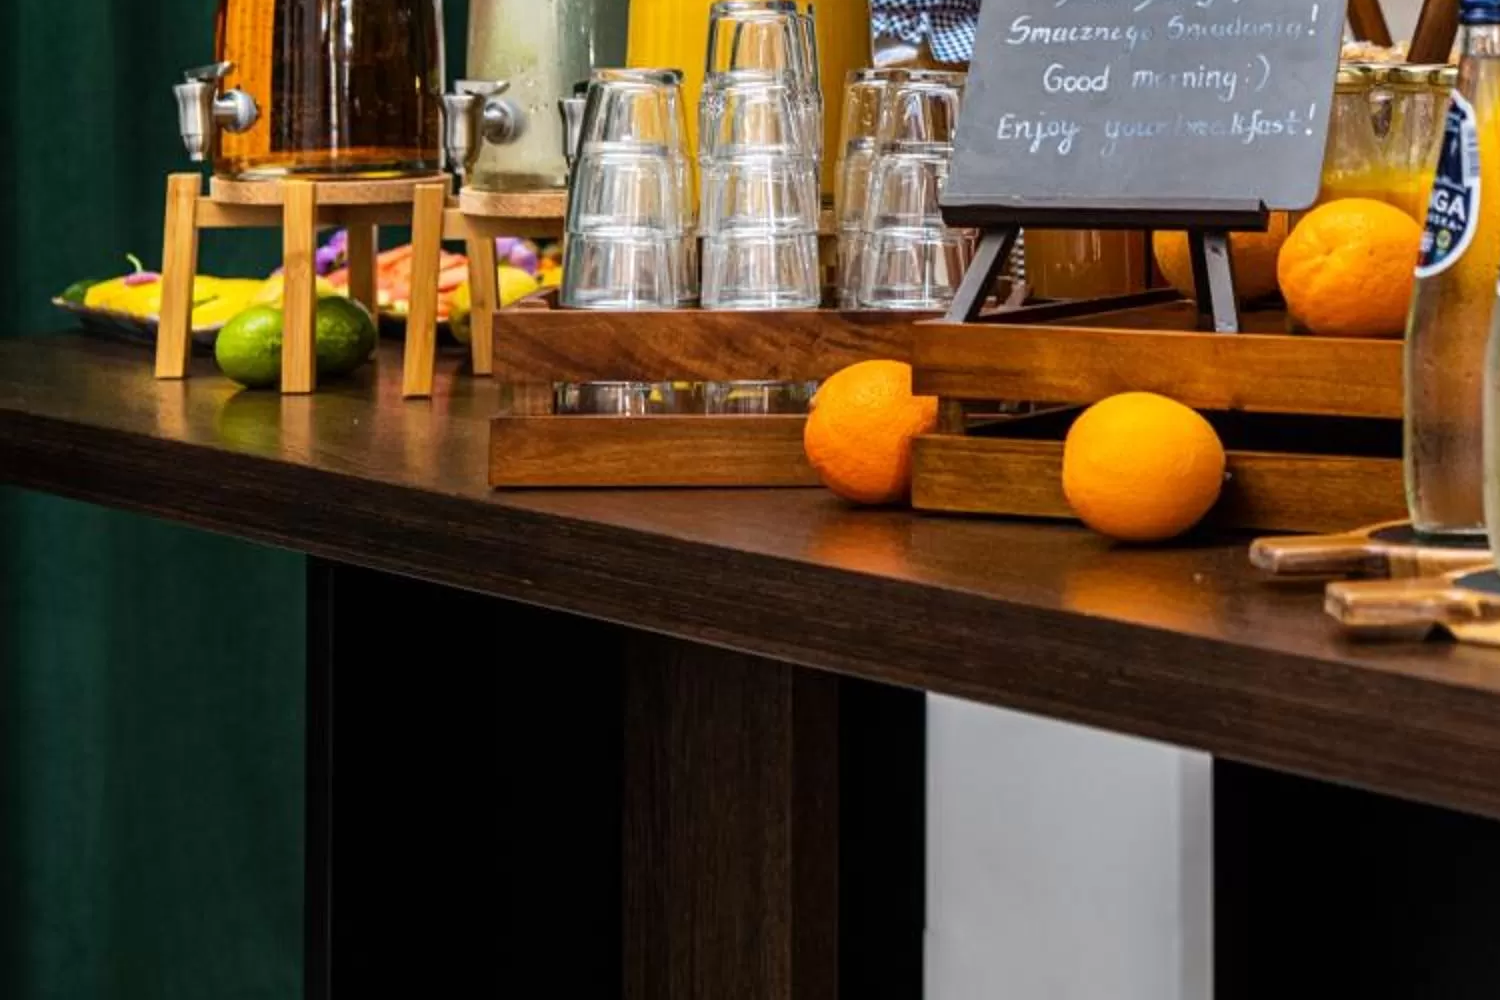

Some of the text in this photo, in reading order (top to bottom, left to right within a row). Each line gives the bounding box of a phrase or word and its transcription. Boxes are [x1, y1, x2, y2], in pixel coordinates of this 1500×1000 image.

[1042, 63, 1111, 93] Good
[997, 111, 1080, 155] Enjoy
[1099, 118, 1168, 157] your
